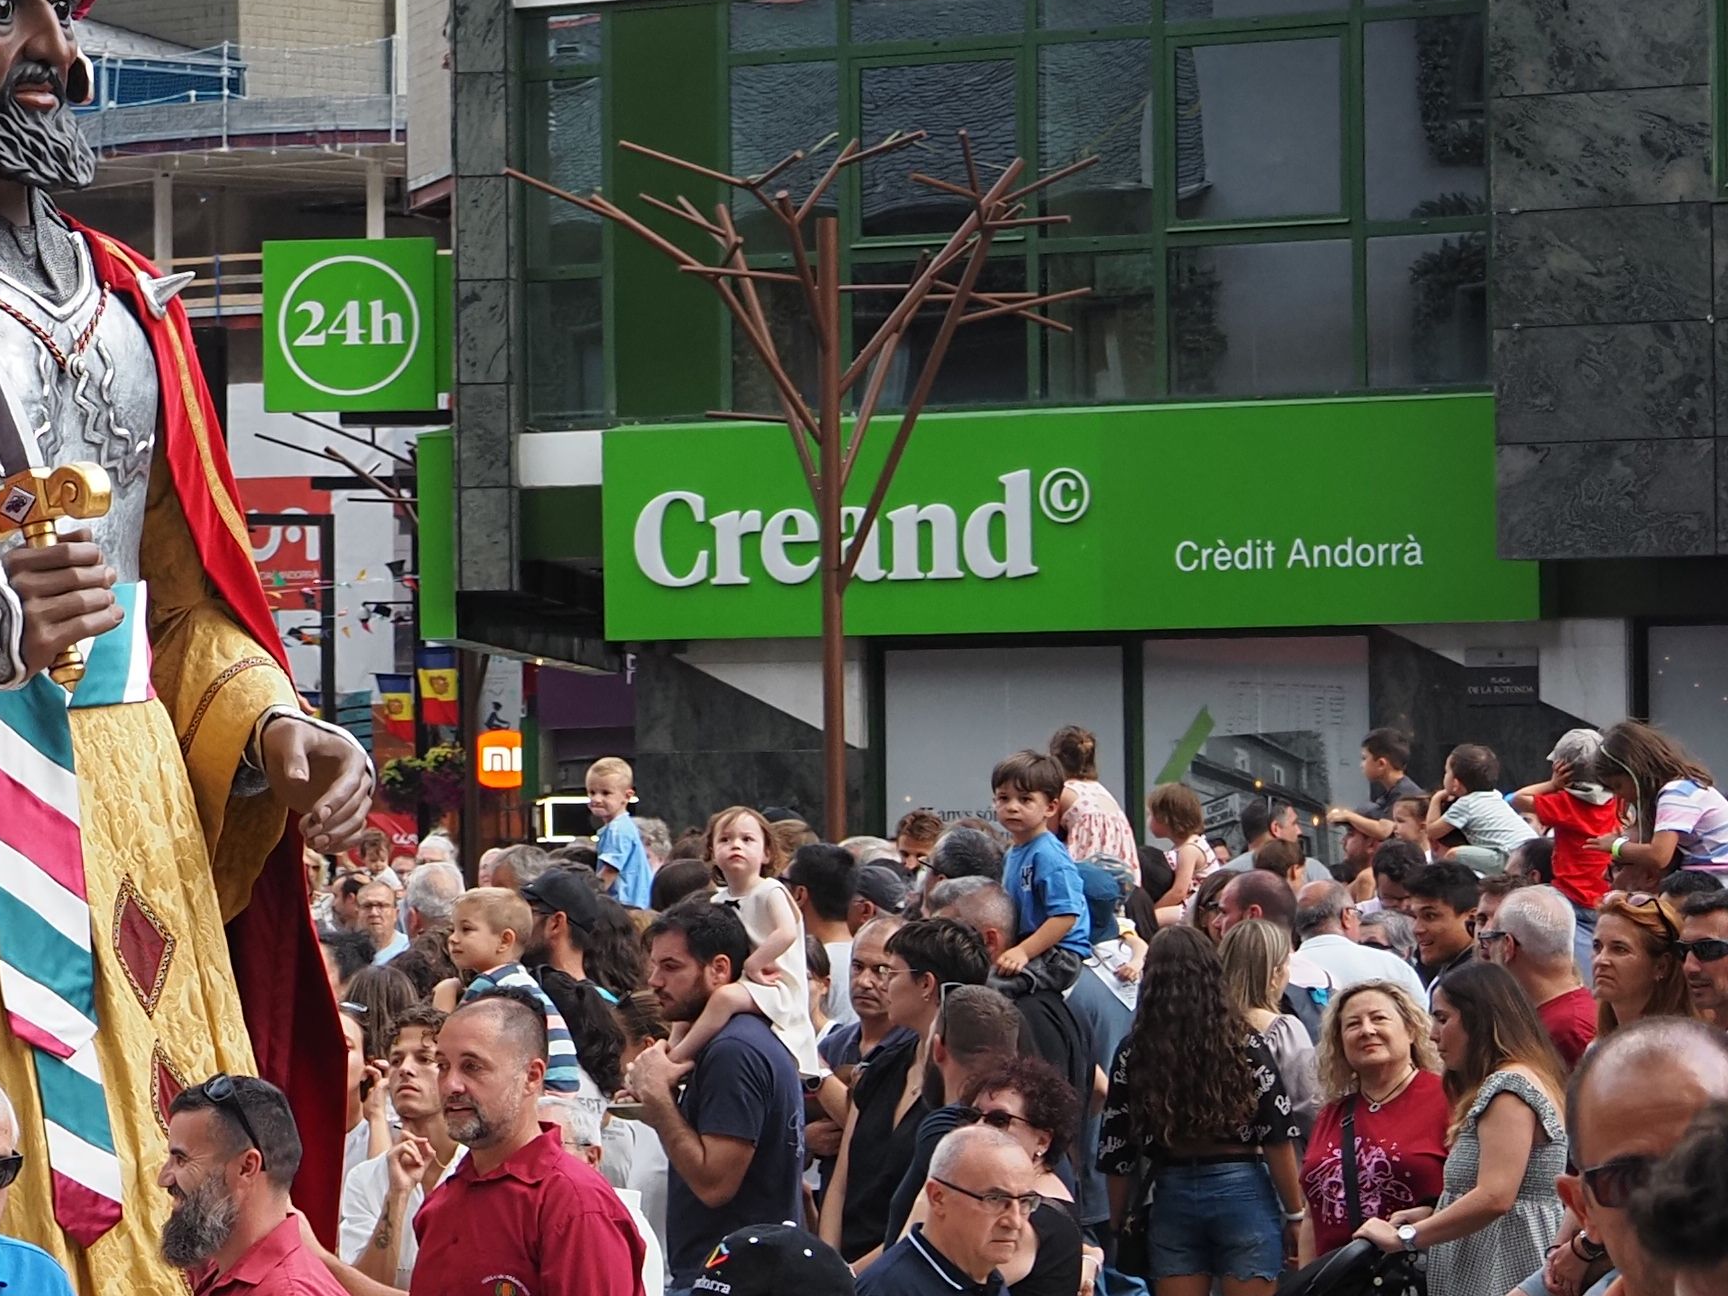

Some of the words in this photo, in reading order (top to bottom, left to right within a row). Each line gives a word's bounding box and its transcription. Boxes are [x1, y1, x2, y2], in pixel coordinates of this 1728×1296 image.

[292, 299, 406, 347] 24h
[1175, 539, 1276, 572] Crèdit
[1286, 534, 1424, 568] Andorrà
